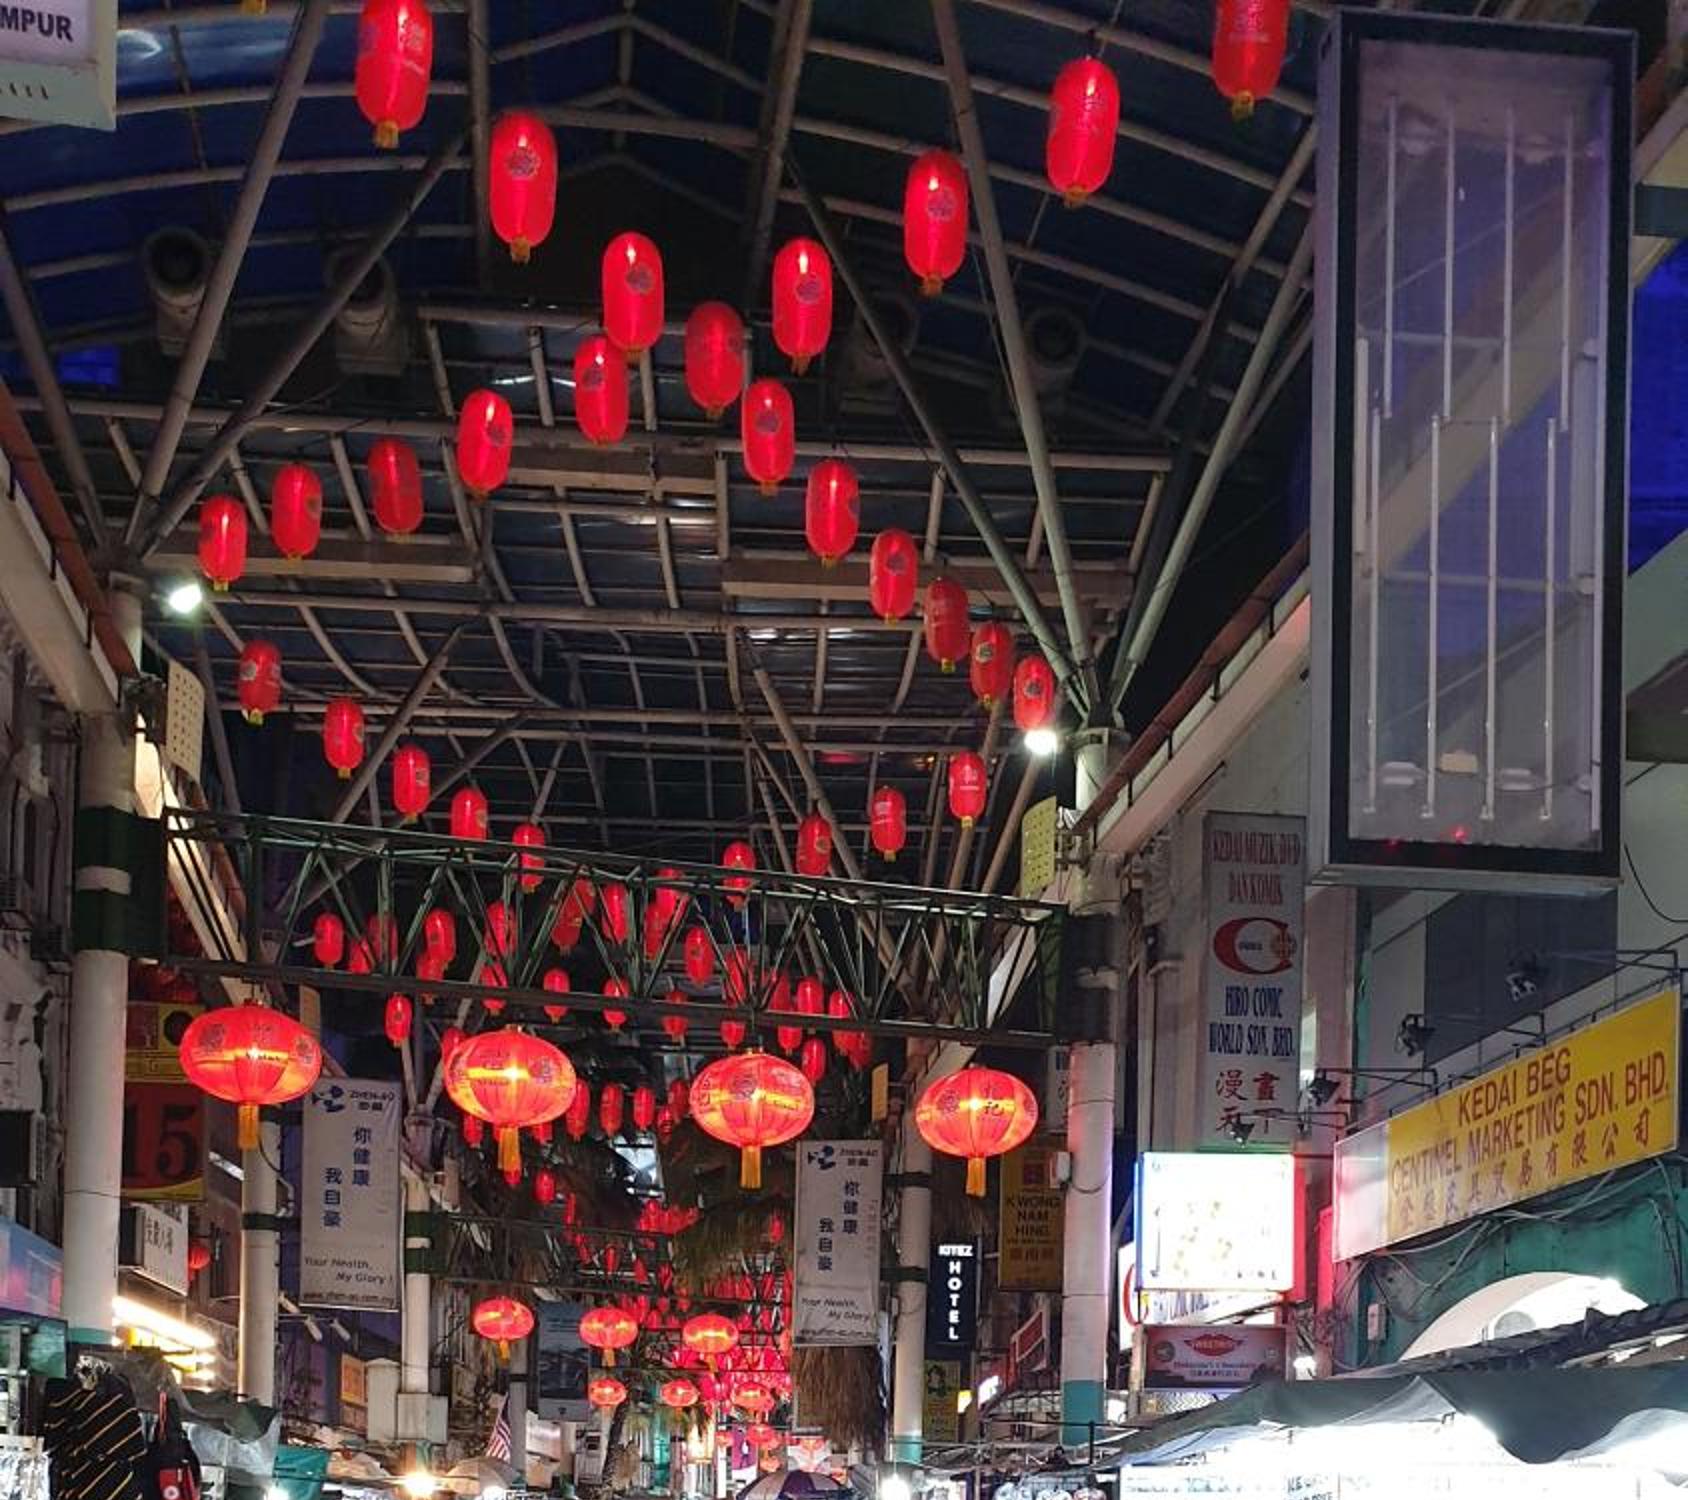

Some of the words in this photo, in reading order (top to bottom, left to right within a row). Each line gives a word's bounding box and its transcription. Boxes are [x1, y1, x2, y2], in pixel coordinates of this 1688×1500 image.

[0, 5, 74, 42] MPUR
[1252, 986, 1284, 1018] COMIC
[1208, 1023, 1243, 1055] WORLD
[1458, 1066, 1518, 1126] KEDAI
[1526, 1047, 1571, 1097] BEG
[1468, 1091, 1566, 1164] MARKETING
[1575, 1071, 1619, 1126] SDN.
[1625, 1050, 1670, 1106] BHD.
[337, 1272, 352, 1283] My
[946, 1261, 963, 1341] HOTEL
